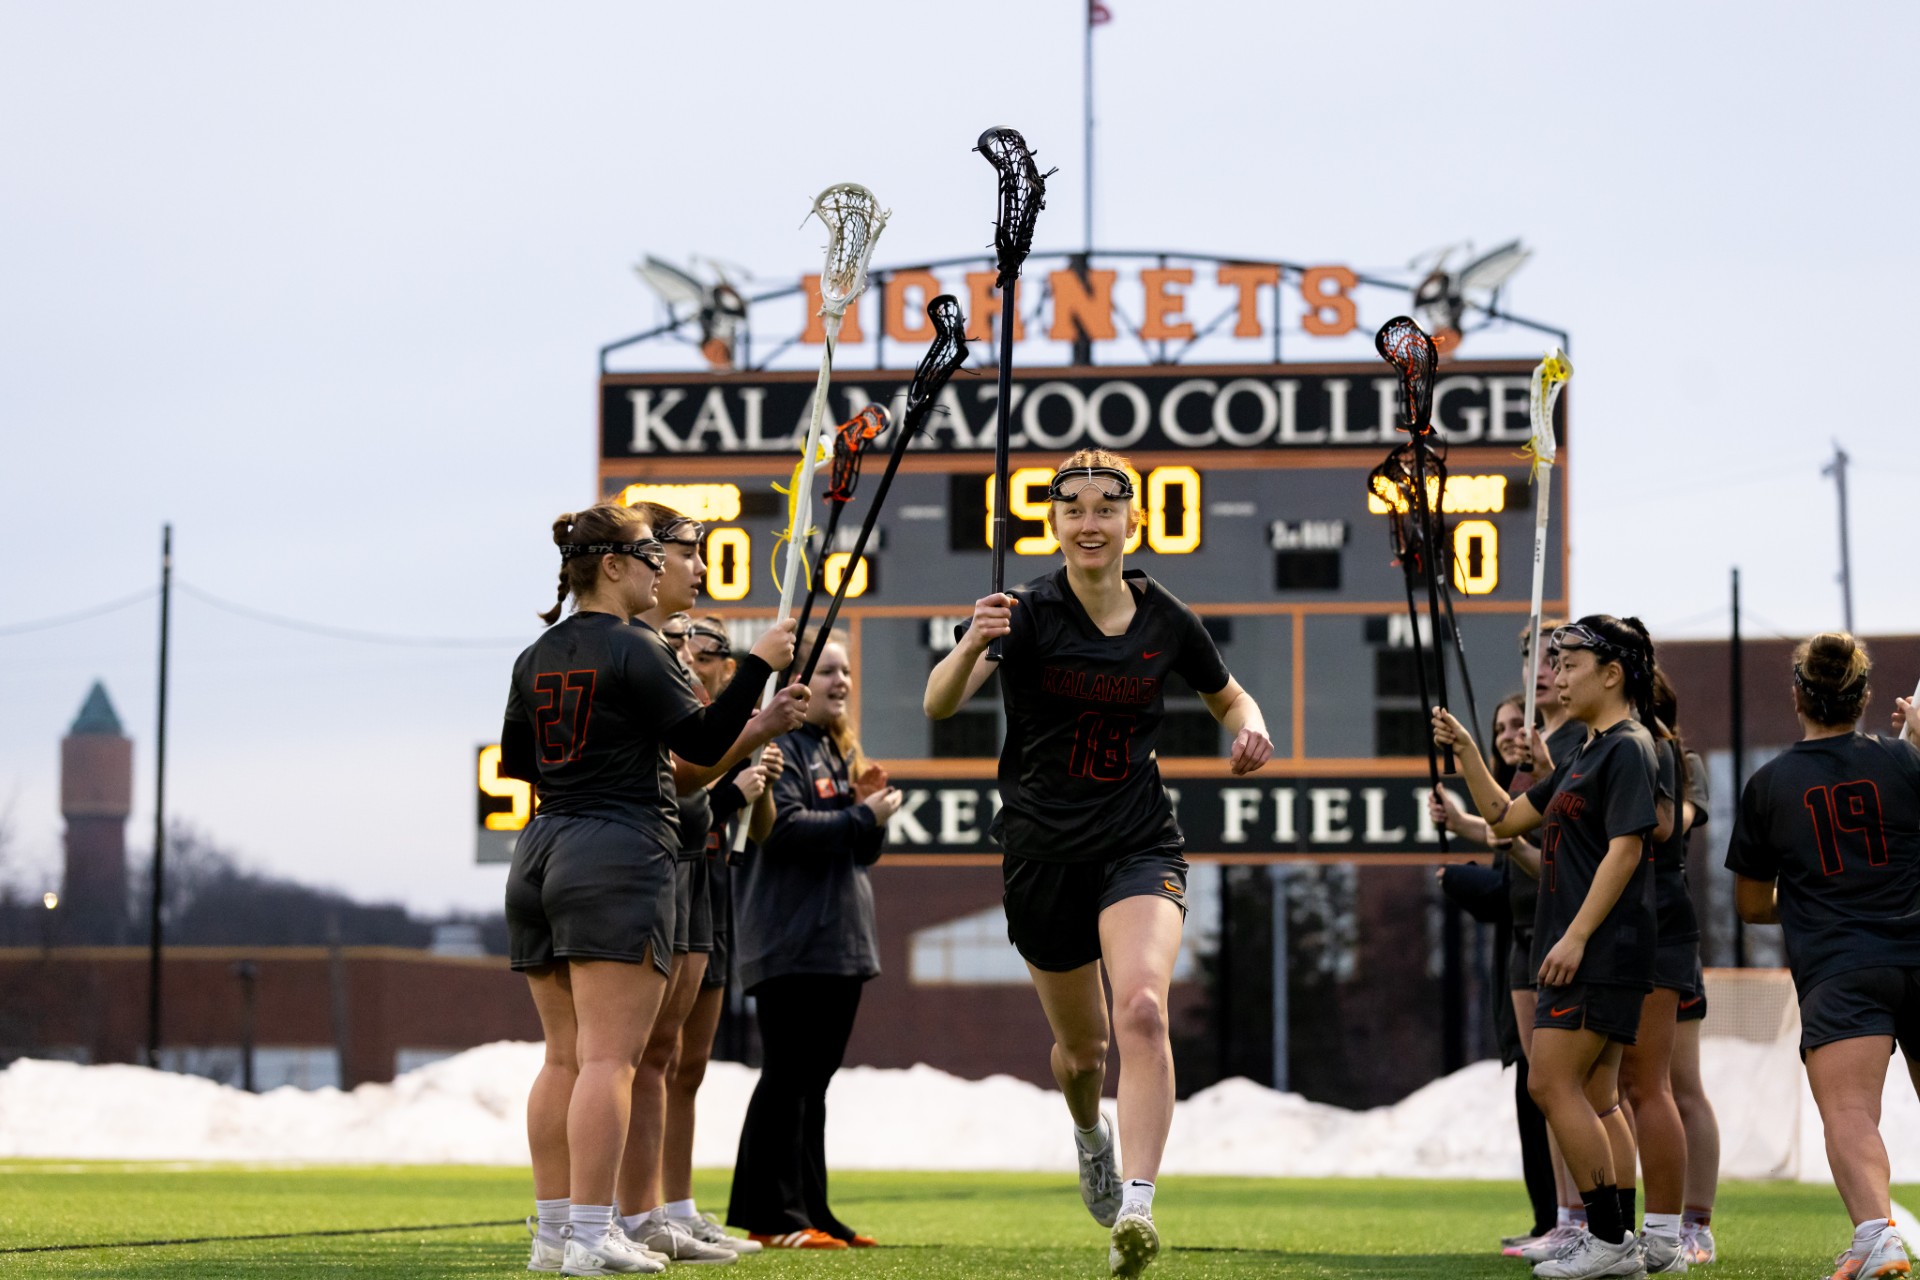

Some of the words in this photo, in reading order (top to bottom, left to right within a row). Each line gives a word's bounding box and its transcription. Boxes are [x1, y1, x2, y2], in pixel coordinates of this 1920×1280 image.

[801, 265, 1358, 344] HORNETS
[627, 379, 1151, 453] KALAMAZOO
[1159, 375, 1533, 449] COLLEGE
[588, 543, 614, 553] STX
[707, 527, 751, 601] 0
[824, 552, 868, 598] 0
[1453, 519, 1499, 595] 0
[534, 669, 597, 764] 27
[1068, 711, 1137, 781] 18
[1803, 779, 1889, 876] 19
